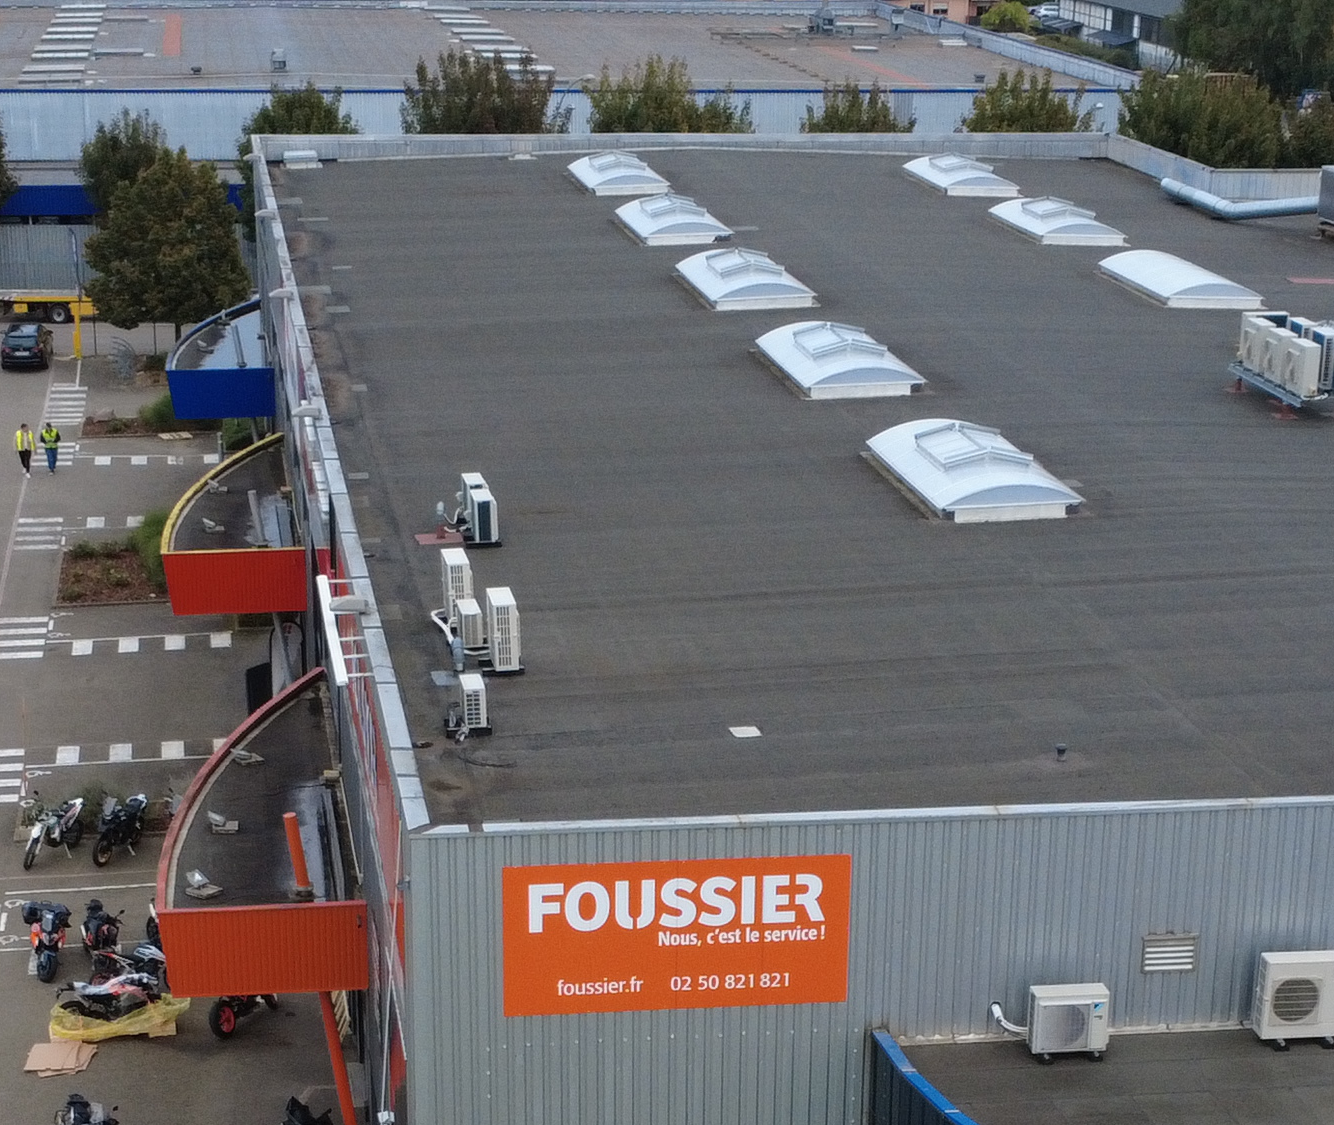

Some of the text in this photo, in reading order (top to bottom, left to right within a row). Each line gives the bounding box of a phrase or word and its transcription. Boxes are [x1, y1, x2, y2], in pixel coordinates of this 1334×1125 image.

[528, 873, 826, 934] FOUSSIER
[657, 930, 702, 948] Nous,
[706, 928, 742, 945] c'est
[745, 926, 761, 943] le
[763, 925, 819, 943] service
[556, 976, 644, 996] foussier.fr
[670, 972, 790, 992] 02 50 821 821
